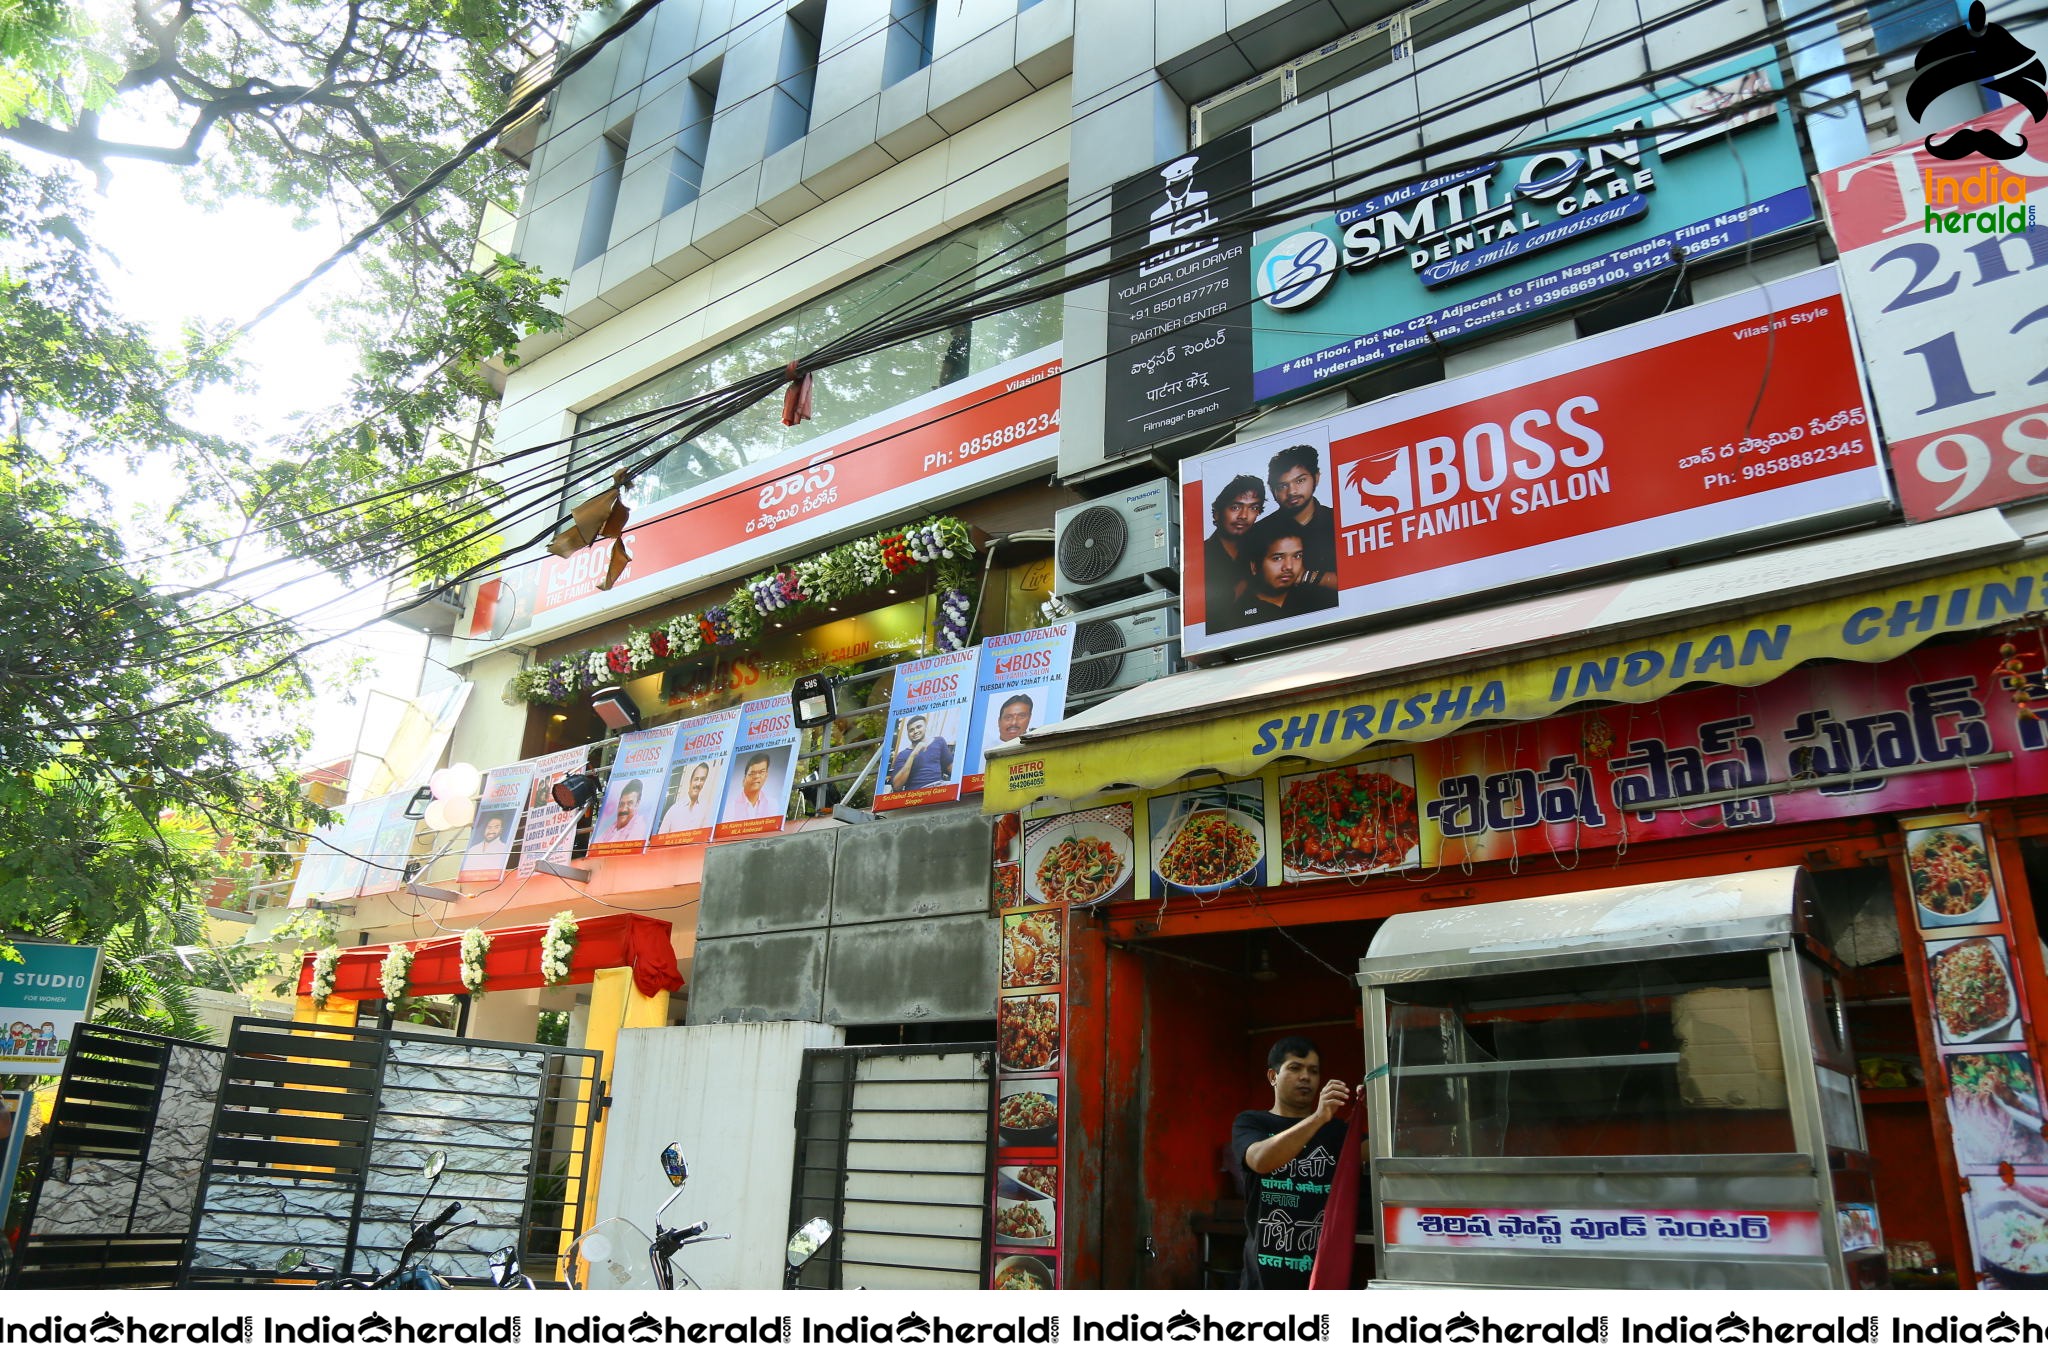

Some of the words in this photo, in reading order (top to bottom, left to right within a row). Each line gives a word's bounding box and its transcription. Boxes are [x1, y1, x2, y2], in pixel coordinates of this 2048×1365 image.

[1339, 210, 1361, 223] Dr.
[1365, 201, 1379, 214] S.
[1384, 187, 1416, 206] Md.
[1411, 212, 1540, 270] DENTAL
[1557, 168, 1655, 216] CARE
[1475, 241, 1519, 267] smile
[1118, 282, 1147, 300] YOUR
[1149, 272, 1174, 289] CAR,
[1176, 262, 1200, 279] OUR
[1202, 245, 1243, 269] DRIVER
[1293, 356, 1313, 371] 4th
[1317, 344, 1351, 363] Floor,
[1354, 334, 1380, 350] Plot
[1383, 327, 1405, 340] No.
[1408, 315, 1438, 331] C22,
[1442, 292, 1503, 321] Adjacent
[1508, 286, 1523, 298] to
[1527, 274, 1558, 292] Film
[1562, 257, 1606, 280] Nagar
[1610, 235, 1672, 264] Temple,
[1675, 221, 1710, 242] Film
[1714, 203, 1770, 228] Nagar,
[1129, 308, 1150, 321] +91
[1153, 279, 1229, 316] 8501877778
[1313, 348, 1385, 379] Hyderabad,
[1464, 302, 1523, 328] Contact
[1633, 231, 1730, 274] 912106851
[1130, 319, 1181, 344] PARTNER
[1183, 302, 1227, 327] CENTER
[1791, 306, 1829, 327] Style
[1006, 370, 1045, 392] Vilasini
[1143, 411, 1186, 432] Filmnagar
[1187, 401, 1219, 421] Branch
[923, 450, 953, 472] Ph:
[1415, 395, 1604, 507] BOSS
[1703, 470, 1737, 490] Ph:
[1742, 439, 1864, 480] 9858882345
[1126, 488, 1161, 503] Panasonic
[1342, 521, 1394, 557] THE
[1401, 493, 1501, 543] FAMILY
[1510, 466, 1610, 515] SALON
[988, 633, 1022, 648] GRAND
[1024, 625, 1067, 642] OPENING
[831, 641, 870, 662] SALON
[901, 659, 932, 675] GRAND
[934, 650, 974, 668] OPENING
[1013, 650, 1052, 671] BOSS
[1252, 681, 1506, 756] SHIRISHA
[1550, 624, 1792, 702] INDIAN
[1842, 570, 2048, 646] CHIN
[923, 674, 959, 695] BOSS
[980, 682, 1005, 692] TUESDAY
[1007, 680, 1019, 688] NOV
[744, 700, 770, 713] GRAND
[893, 706, 916, 716] TUESDAY
[917, 704, 928, 712] NOV
[761, 715, 791, 733] BOSS
[696, 731, 723, 748] BOSS
[636, 746, 661, 761] BOSS
[1009, 761, 1045, 775] METRO
[1009, 771, 1045, 782] AWNINGS
[531, 808, 544, 819] MEN
[14, 972, 85, 988] STUDIO
[39, 995, 67, 1003] WOMEN
